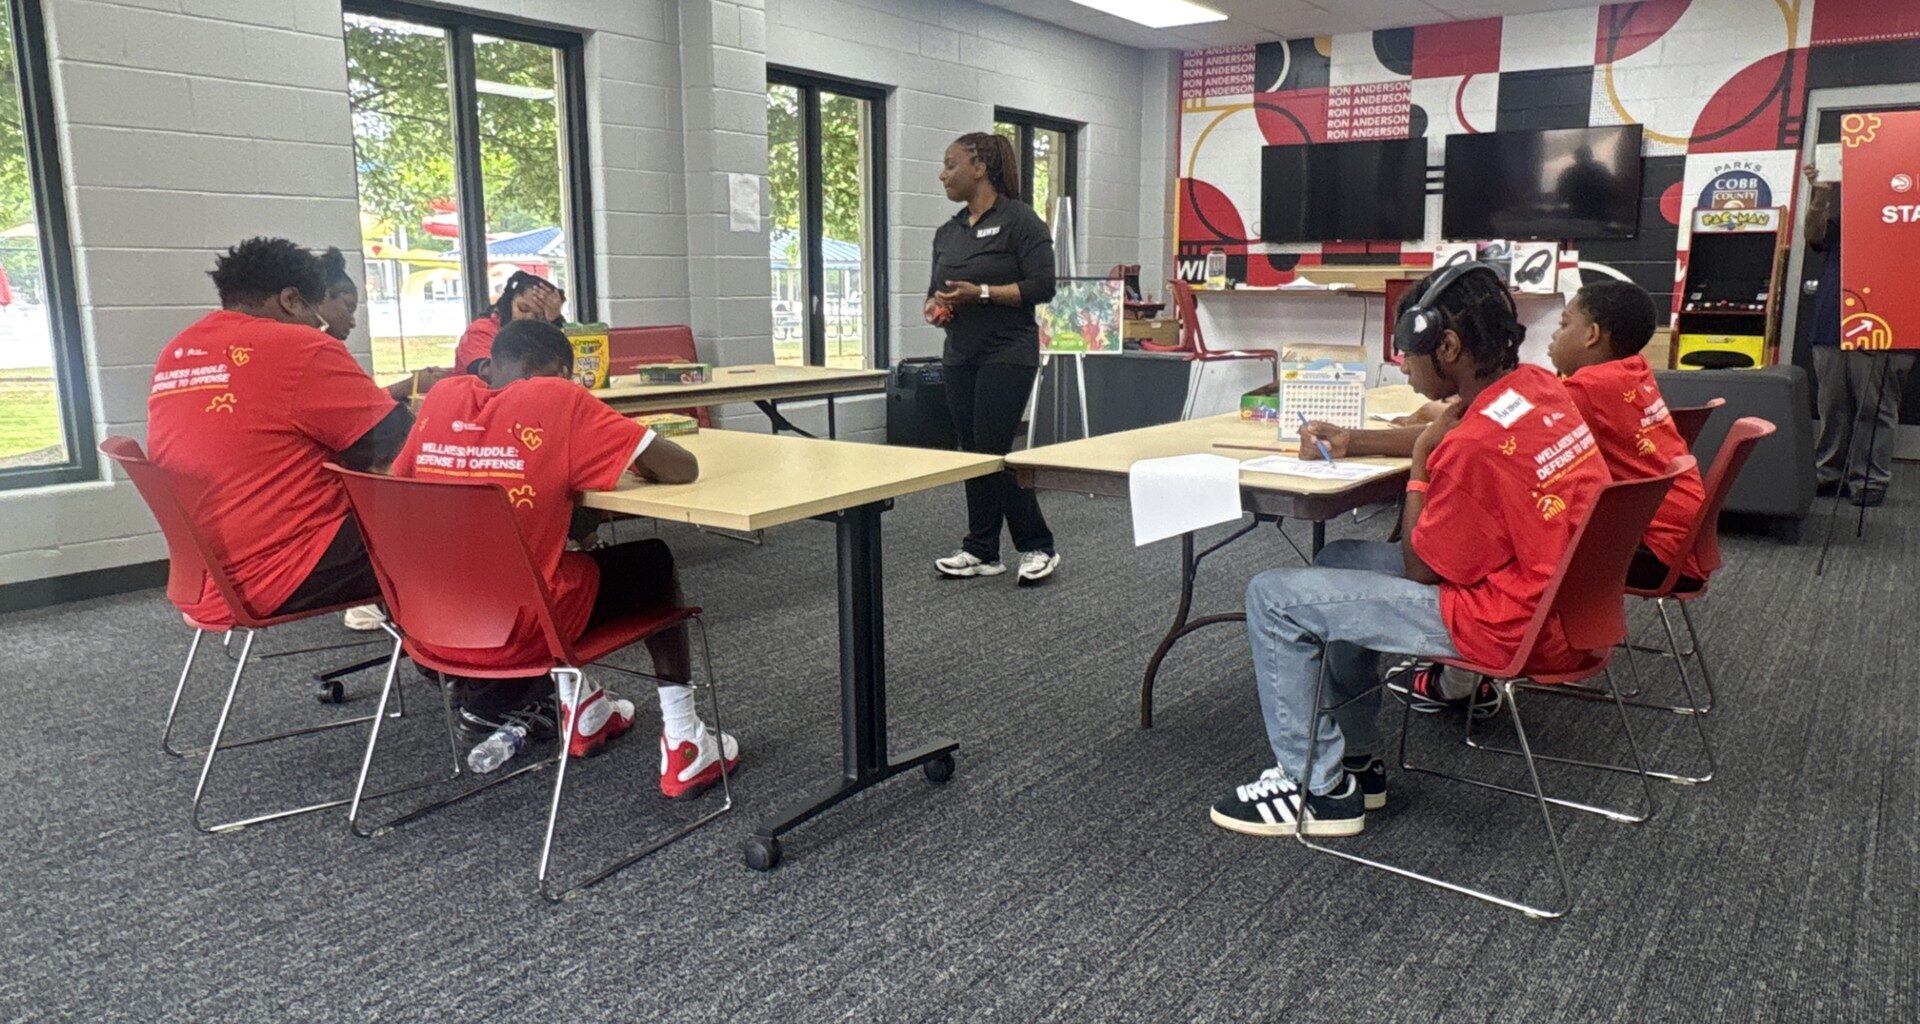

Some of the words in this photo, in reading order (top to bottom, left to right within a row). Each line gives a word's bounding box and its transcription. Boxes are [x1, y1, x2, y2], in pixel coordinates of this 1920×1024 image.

[1183, 59, 1204, 68] RON
[1205, 53, 1256, 66] ANDERSON
[1183, 69, 1203, 78] RON
[1205, 64, 1255, 76] ANDERSON
[1183, 79, 1203, 88] RON
[1204, 74, 1255, 86] ANDERSON
[1182, 89, 1202, 98] RON
[1204, 84, 1254, 96] ANDERSON
[1329, 86, 1352, 96] RON
[1354, 81, 1412, 95] ANDERSON
[1328, 97, 1351, 107] RON
[1353, 92, 1411, 105] ANDERSON
[1328, 108, 1351, 118] RON
[1352, 103, 1410, 116] ANDERSON
[1327, 119, 1350, 129] RON
[1351, 114, 1410, 127] ANDERSON
[1326, 130, 1349, 140] RON
[1351, 125, 1409, 138] ANDERSON
[1714, 161, 1762, 174] PARKS
[1715, 178, 1758, 190] COBB
[1715, 192, 1756, 200] COUNTY
[1702, 212, 1770, 226] PAC-MAN
[466, 446, 519, 458] HUDDLE:
[416, 454, 455, 468] DEFENSE
[469, 459, 525, 471] OFFENSE
